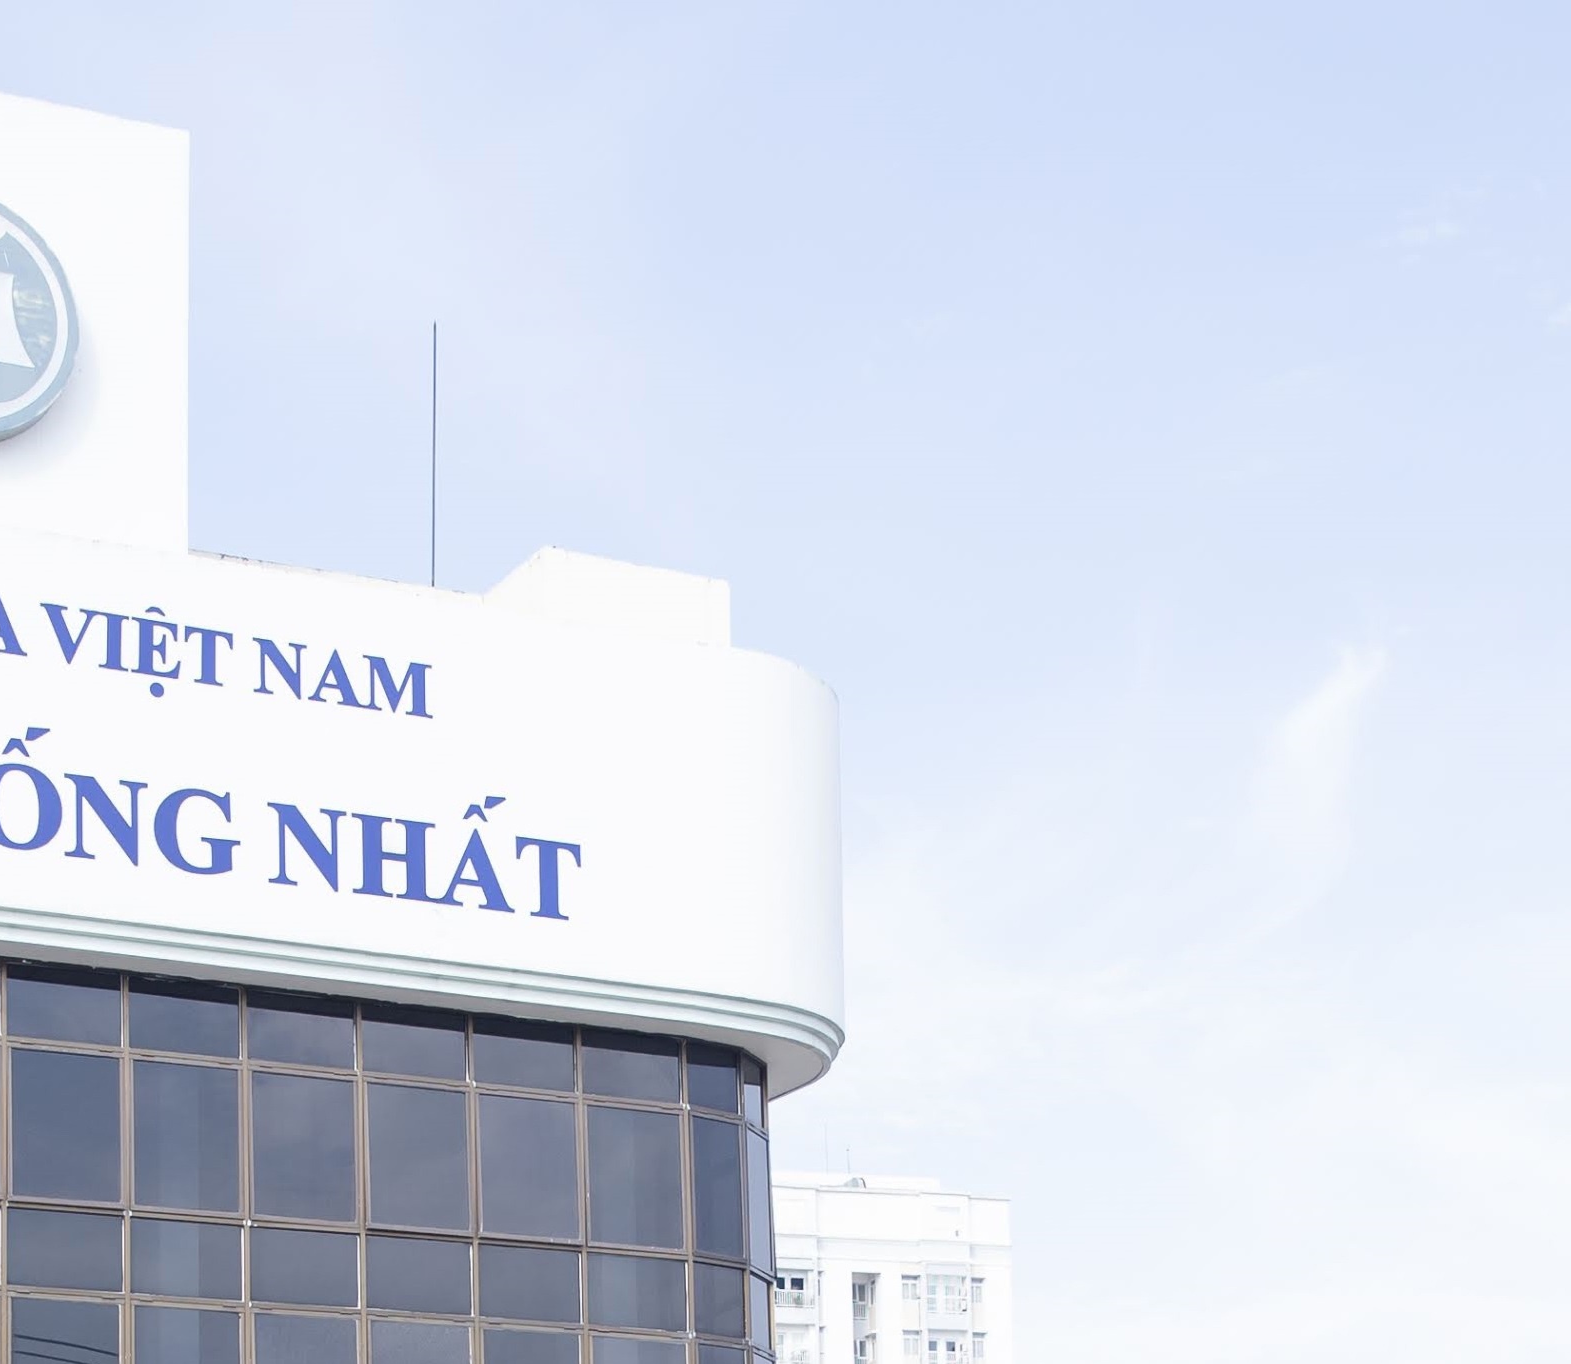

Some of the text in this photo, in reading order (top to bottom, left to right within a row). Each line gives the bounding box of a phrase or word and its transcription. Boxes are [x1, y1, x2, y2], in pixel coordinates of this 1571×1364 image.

[40, 603, 235, 699] VIỆT
[252, 636, 434, 719] NAM
[267, 796, 582, 922] NHẤT
